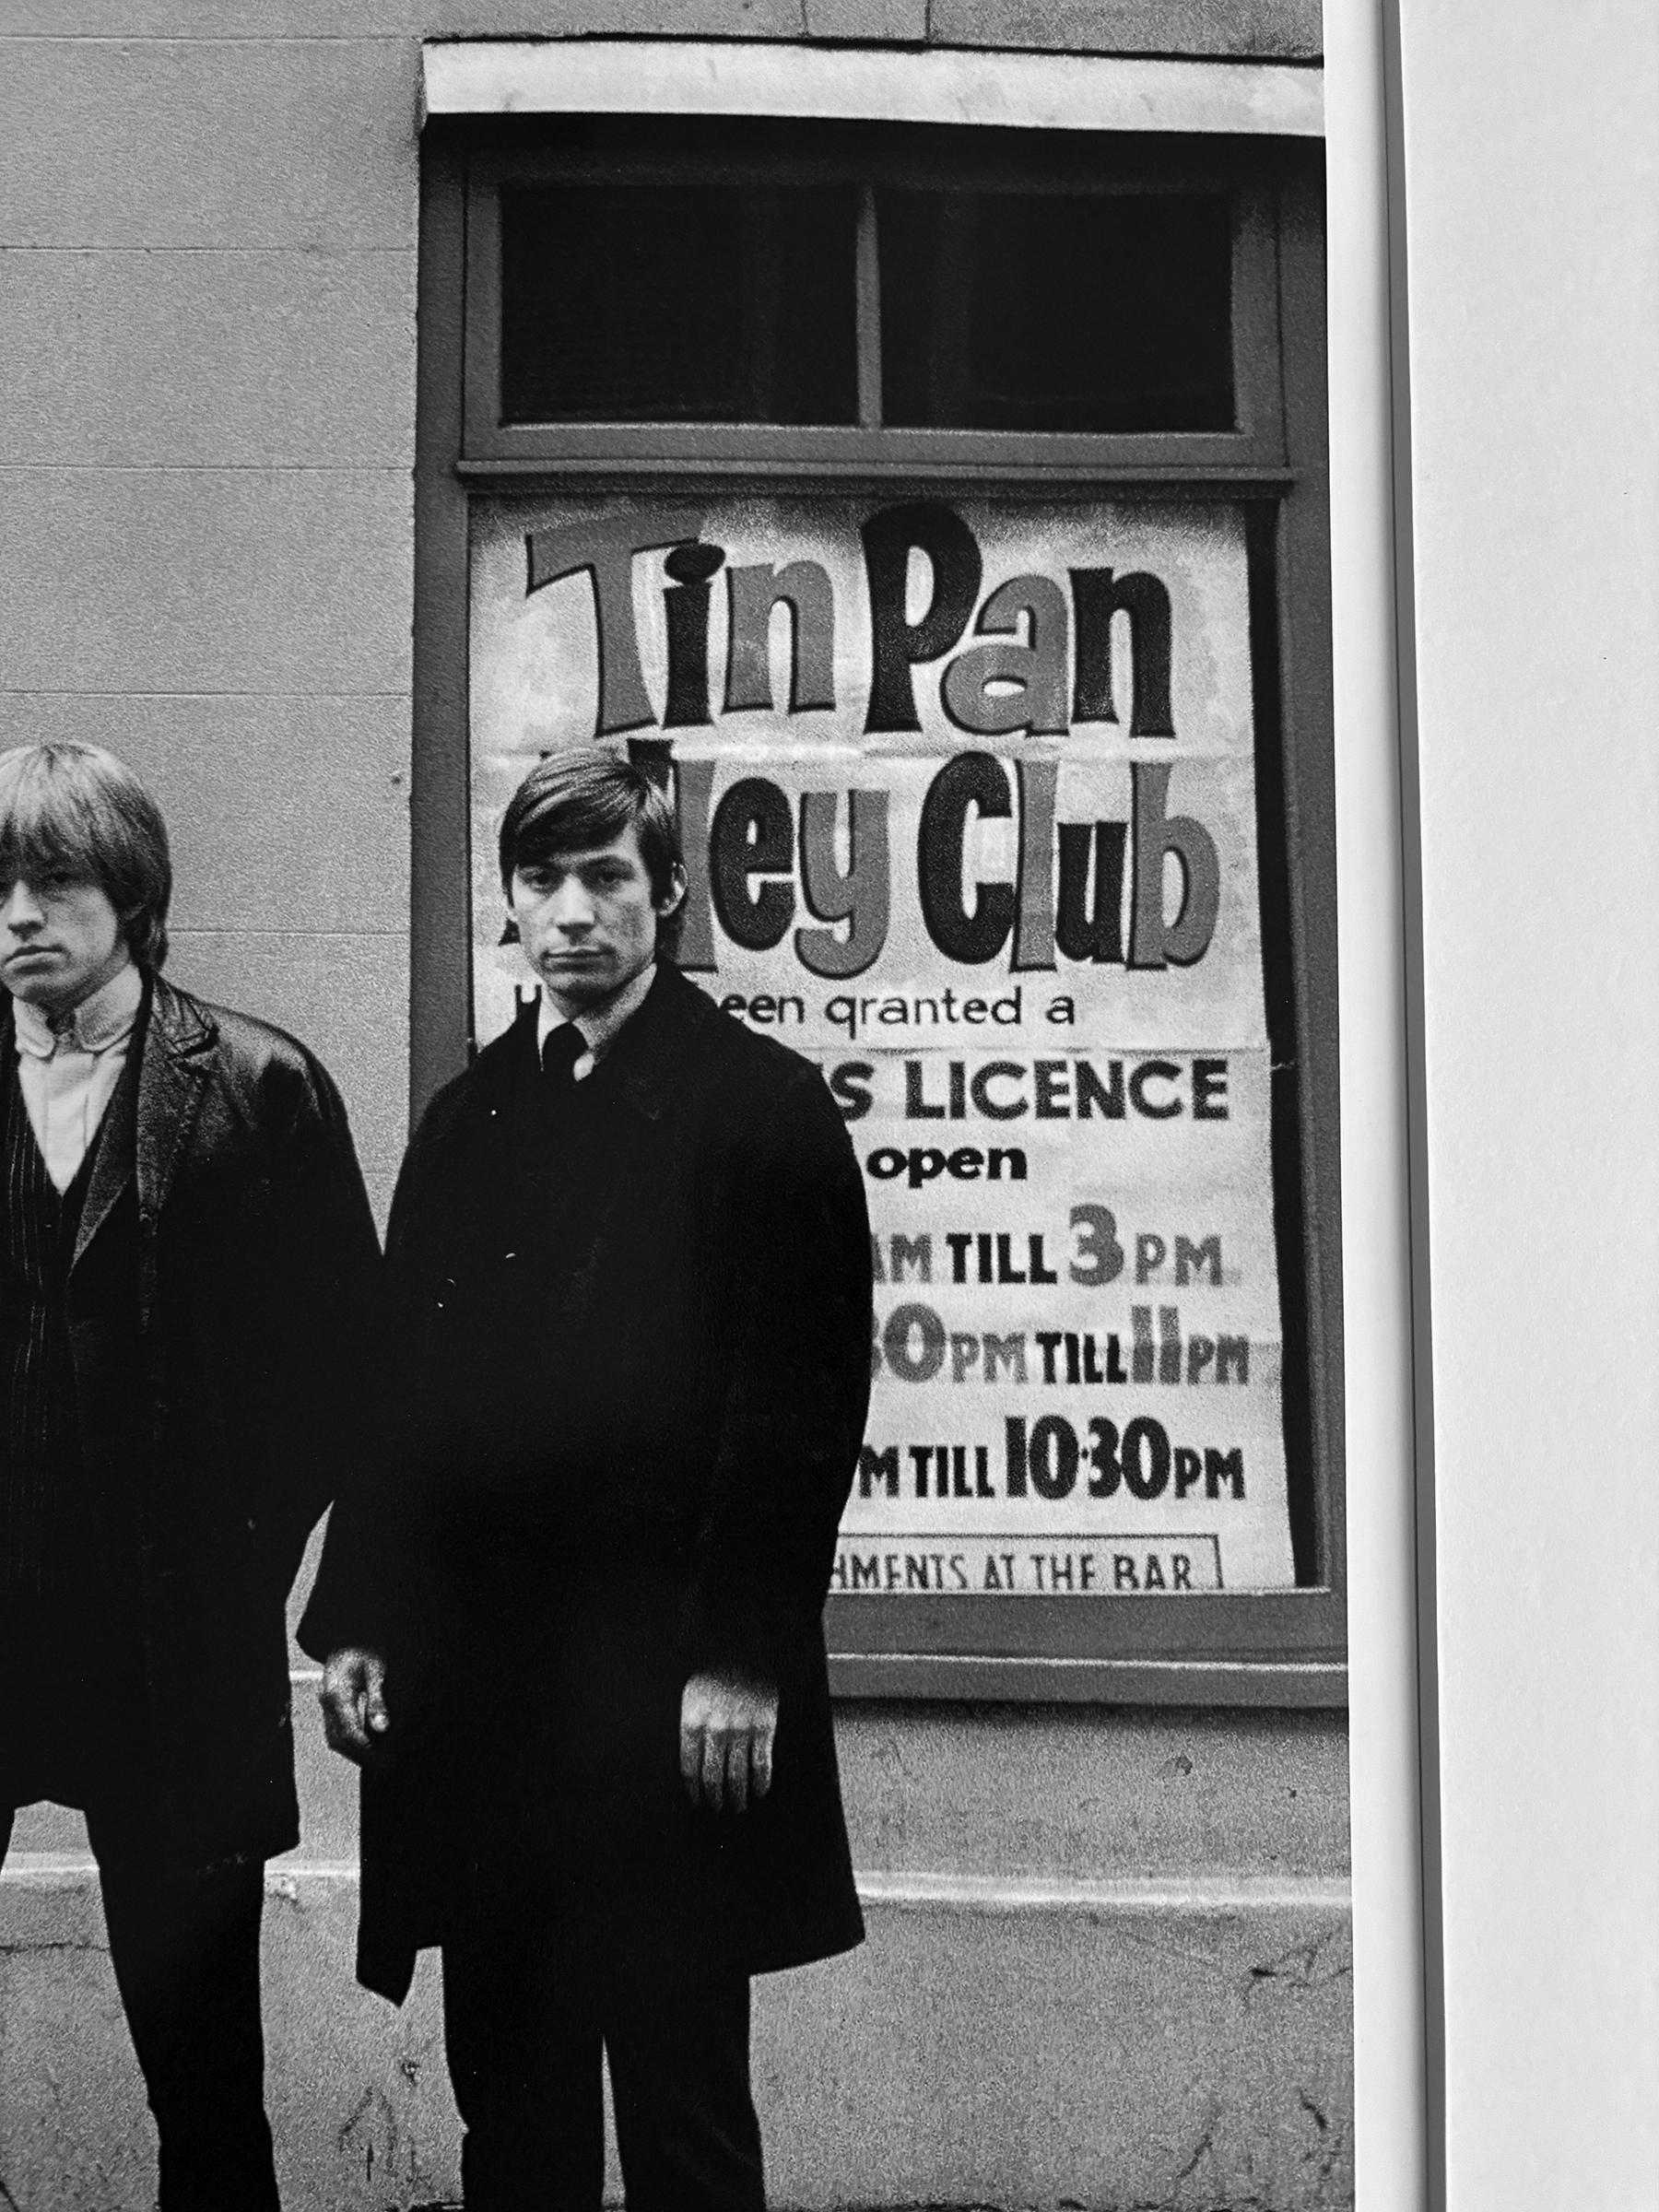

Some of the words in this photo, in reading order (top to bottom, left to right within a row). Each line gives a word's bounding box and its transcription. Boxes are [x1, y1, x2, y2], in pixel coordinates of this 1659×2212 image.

[525, 507, 836, 738] Tin
[859, 502, 1176, 738] Pan
[917, 750, 1218, 973] Club
[717, 994, 806, 1025] een
[1044, 994, 1075, 1026] a
[903, 1060, 1230, 1121] LICENCE
[865, 1147, 1028, 1189] open
[946, 1233, 1057, 1284] TILL
[1035, 1332, 1127, 1383] TILL
[909, 1445, 994, 1498] TILL
[982, 1553, 1015, 1590] AT
[1112, 1554, 1193, 1591] BAR
